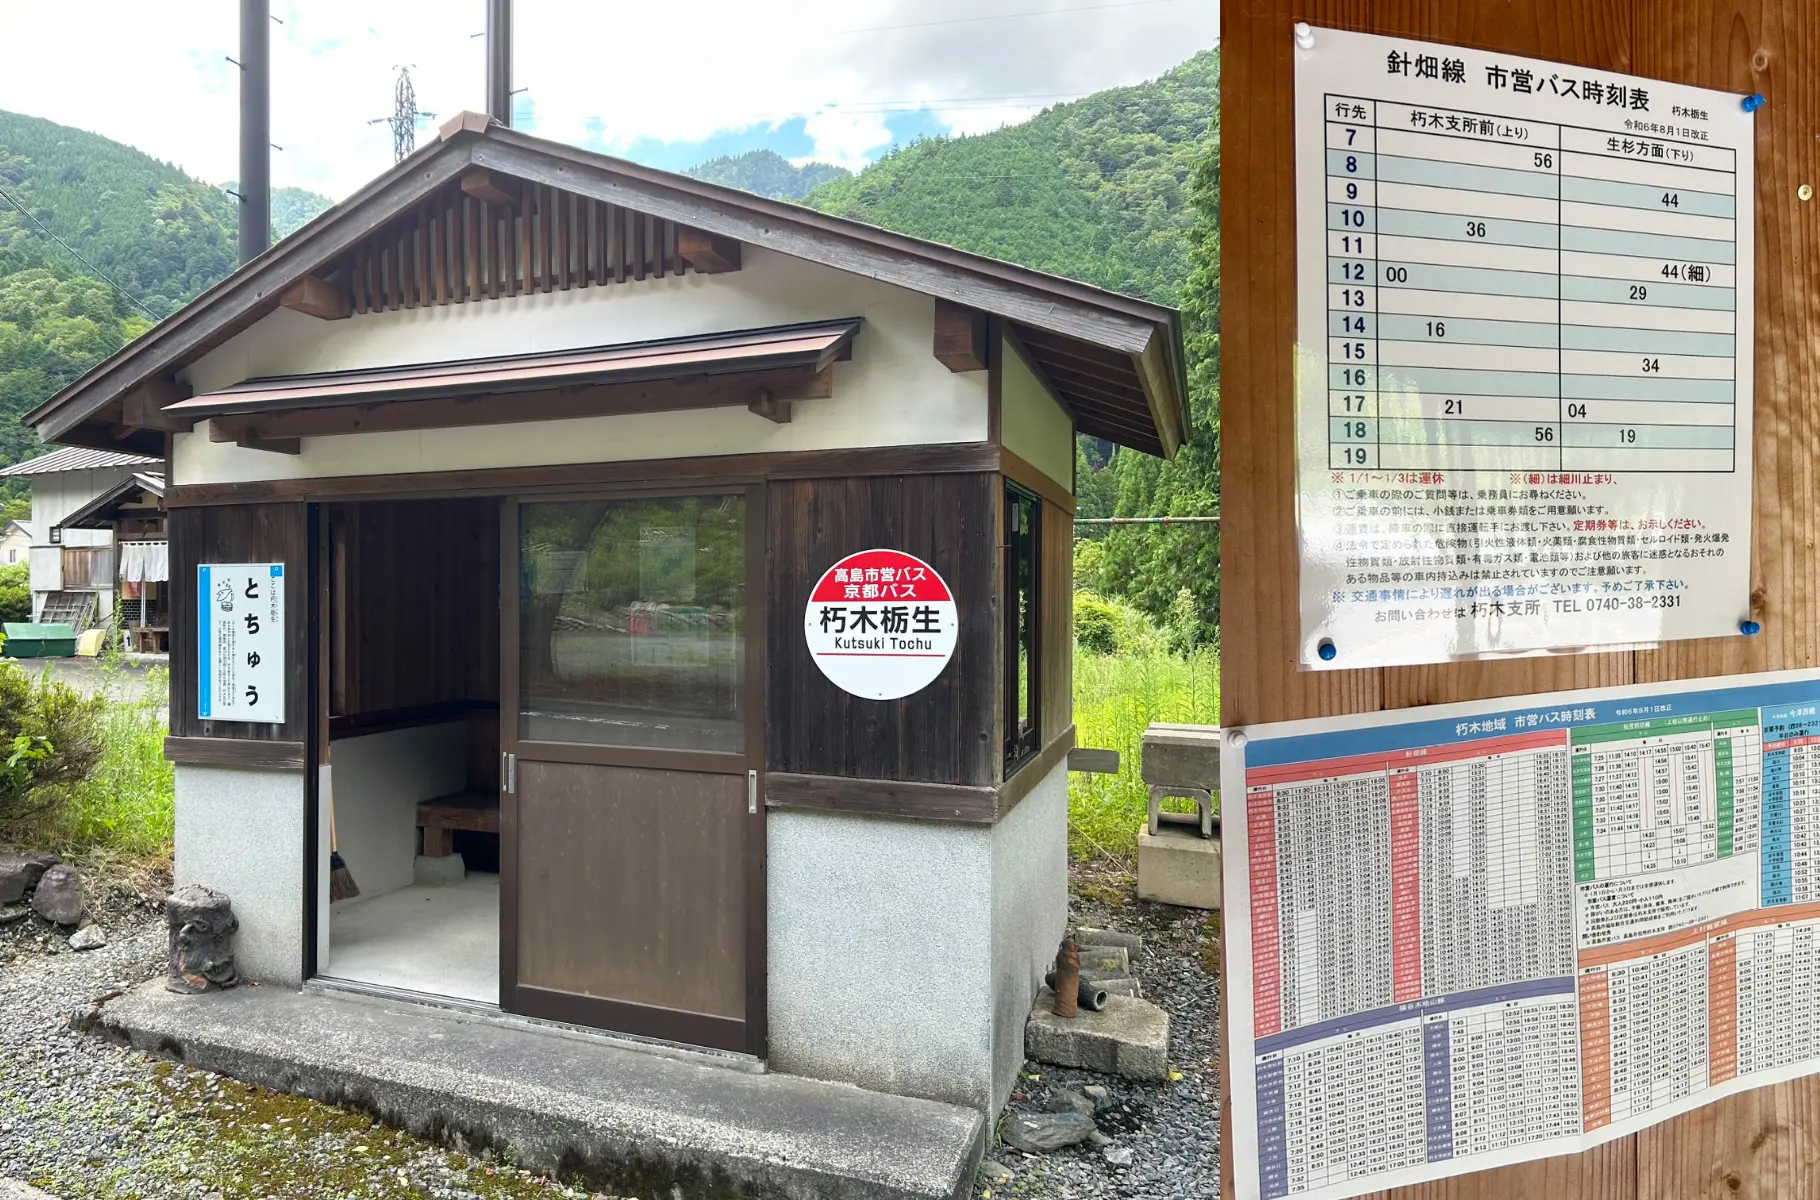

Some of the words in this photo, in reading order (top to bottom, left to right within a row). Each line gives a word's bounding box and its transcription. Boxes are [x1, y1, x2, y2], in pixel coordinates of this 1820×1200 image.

[1386, 50, 1466, 84] 針畑線
[1485, 64, 1650, 112] 市営バス時刻表
[1335, 102, 1367, 120] 行先
[1671, 105, 1709, 121] 朽木栃生
[1345, 129, 1357, 146] 7
[1624, 118, 1709, 141] 令和6年8月1日改正
[1345, 156, 1357, 173] 8
[1534, 152, 1553, 169] 56
[1346, 183, 1358, 200] 9
[1661, 192, 1679, 209] 44
[1341, 210, 1365, 227] 10
[1466, 222, 1486, 239] 36
[1342, 236, 1363, 254] 11
[1342, 263, 1365, 281] 12
[1386, 267, 1408, 284] 00
[1342, 290, 1364, 307] 13
[1629, 285, 1647, 301] 29
[1342, 316, 1365, 334] 14
[1426, 321, 1445, 338] 16
[1342, 343, 1365, 360] 15
[1642, 358, 1660, 374] 34
[1343, 369, 1366, 386] 16
[1343, 396, 1366, 412] 17
[1445, 400, 1463, 415] 21
[1568, 403, 1587, 419] 04
[1344, 422, 1366, 438] 18
[1535, 427, 1553, 443] 56
[1619, 429, 1636, 443] 19
[1344, 448, 1366, 464] 19
[834, 567, 927, 583] 高島市営バス
[844, 584, 917, 599] 京都バス
[1471, 599, 1540, 618] 朽木支所
[1553, 599, 1581, 613] TEL
[1586, 595, 1681, 612] 0740-38-2331
[820, 605, 941, 634] 朽木栃生
[244, 578, 261, 707] とちゅう
[835, 637, 885, 650] Kutsuki
[890, 638, 932, 650] Tochu
[1456, 716, 1507, 736] 朽木地域
[1515, 708, 1596, 728] 市営バス時刻表
